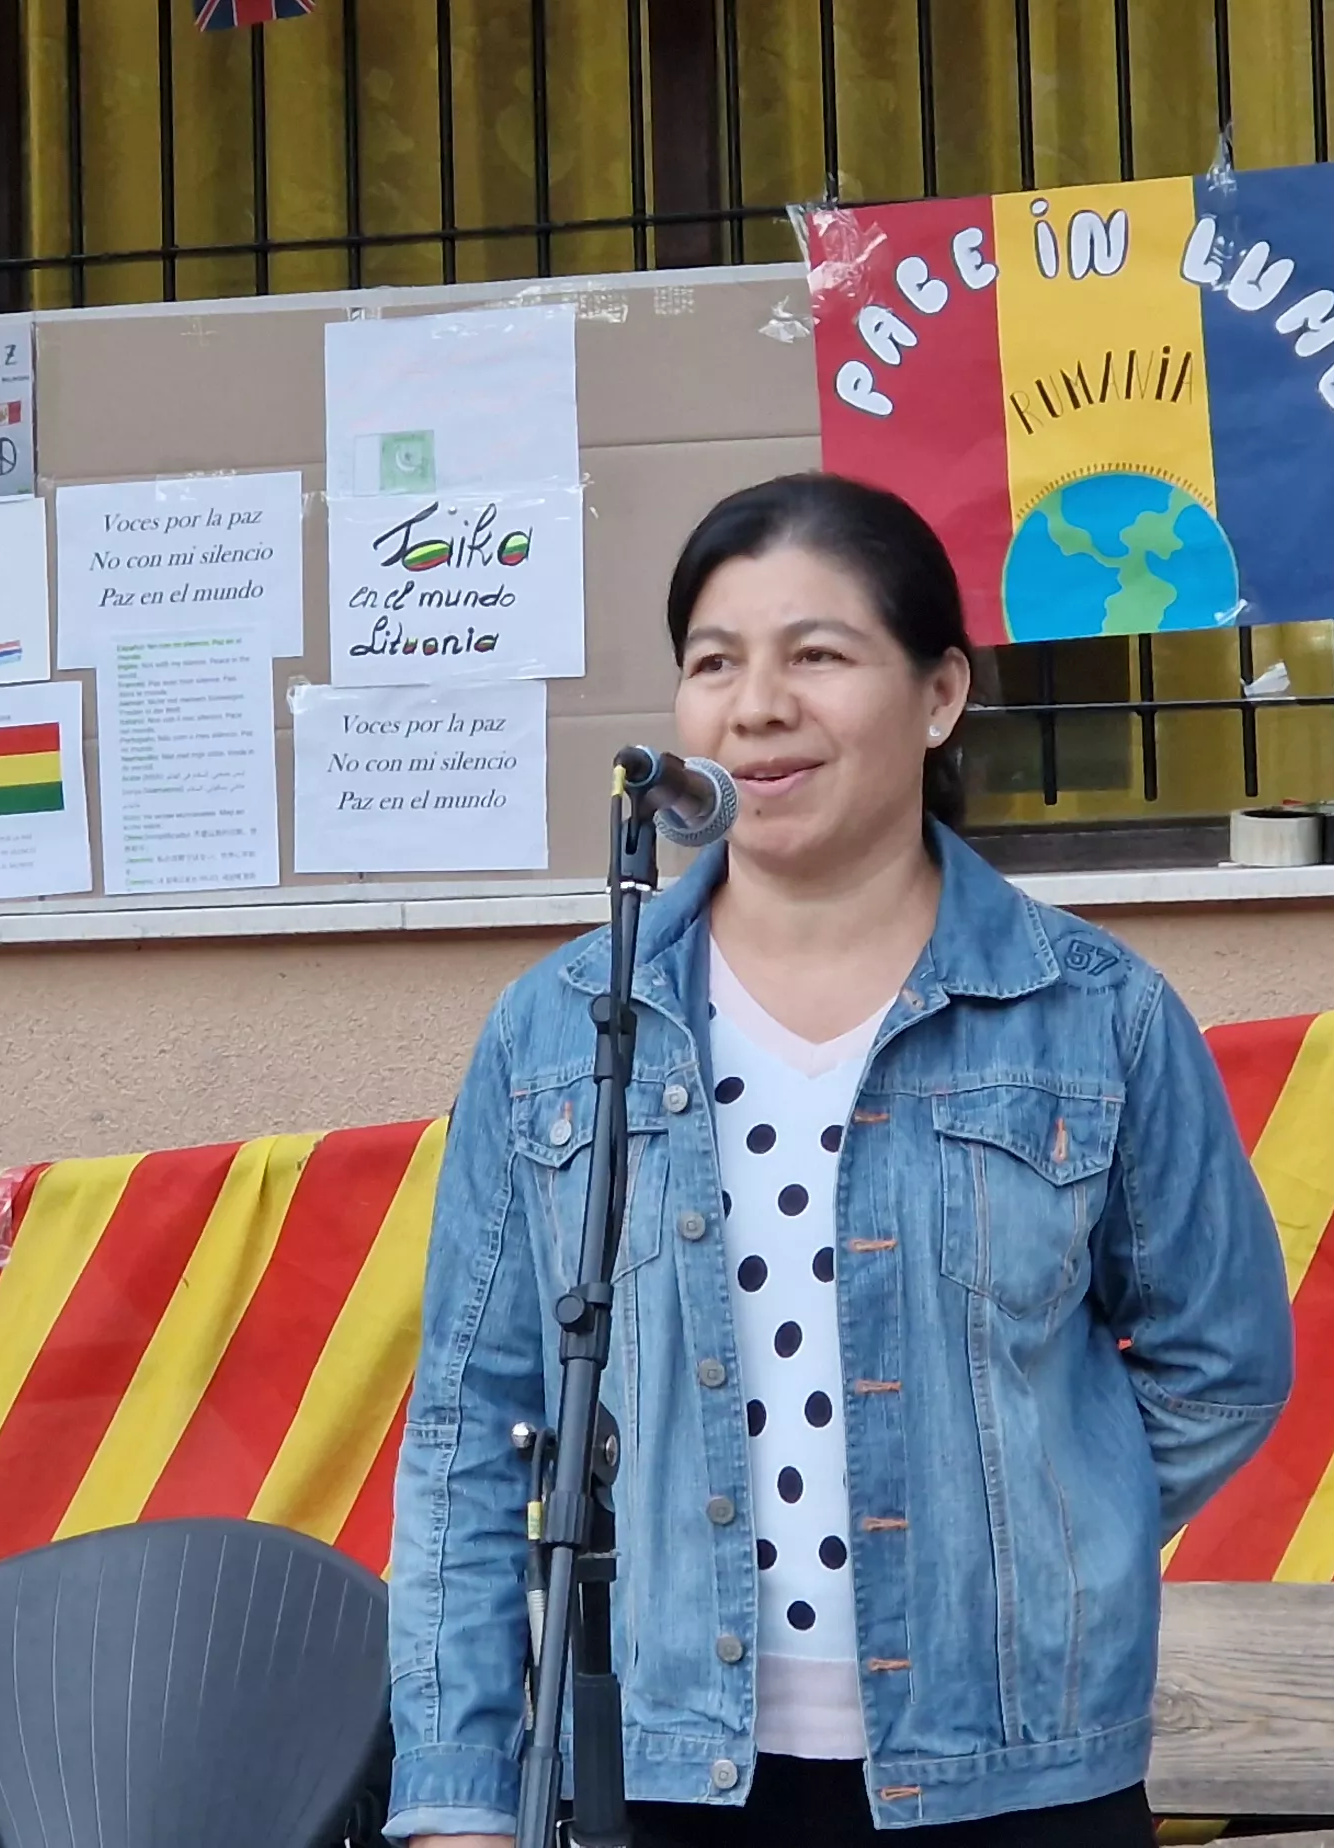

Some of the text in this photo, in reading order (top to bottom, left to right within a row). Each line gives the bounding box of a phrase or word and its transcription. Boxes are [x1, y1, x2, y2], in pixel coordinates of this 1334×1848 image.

[835, 227, 998, 417] PACE
[103, 507, 264, 534] Voces por la paz
[372, 500, 534, 573] Taika
[89, 541, 274, 571] No con mi silencio
[98, 579, 265, 608] Paz en el mundo
[349, 580, 517, 612] en el mundo
[342, 712, 507, 739] Voces por la paz
[327, 750, 518, 773] No con mi silencio
[337, 788, 507, 811] Paz en el mundo
[1064, 938, 1119, 977] 57
